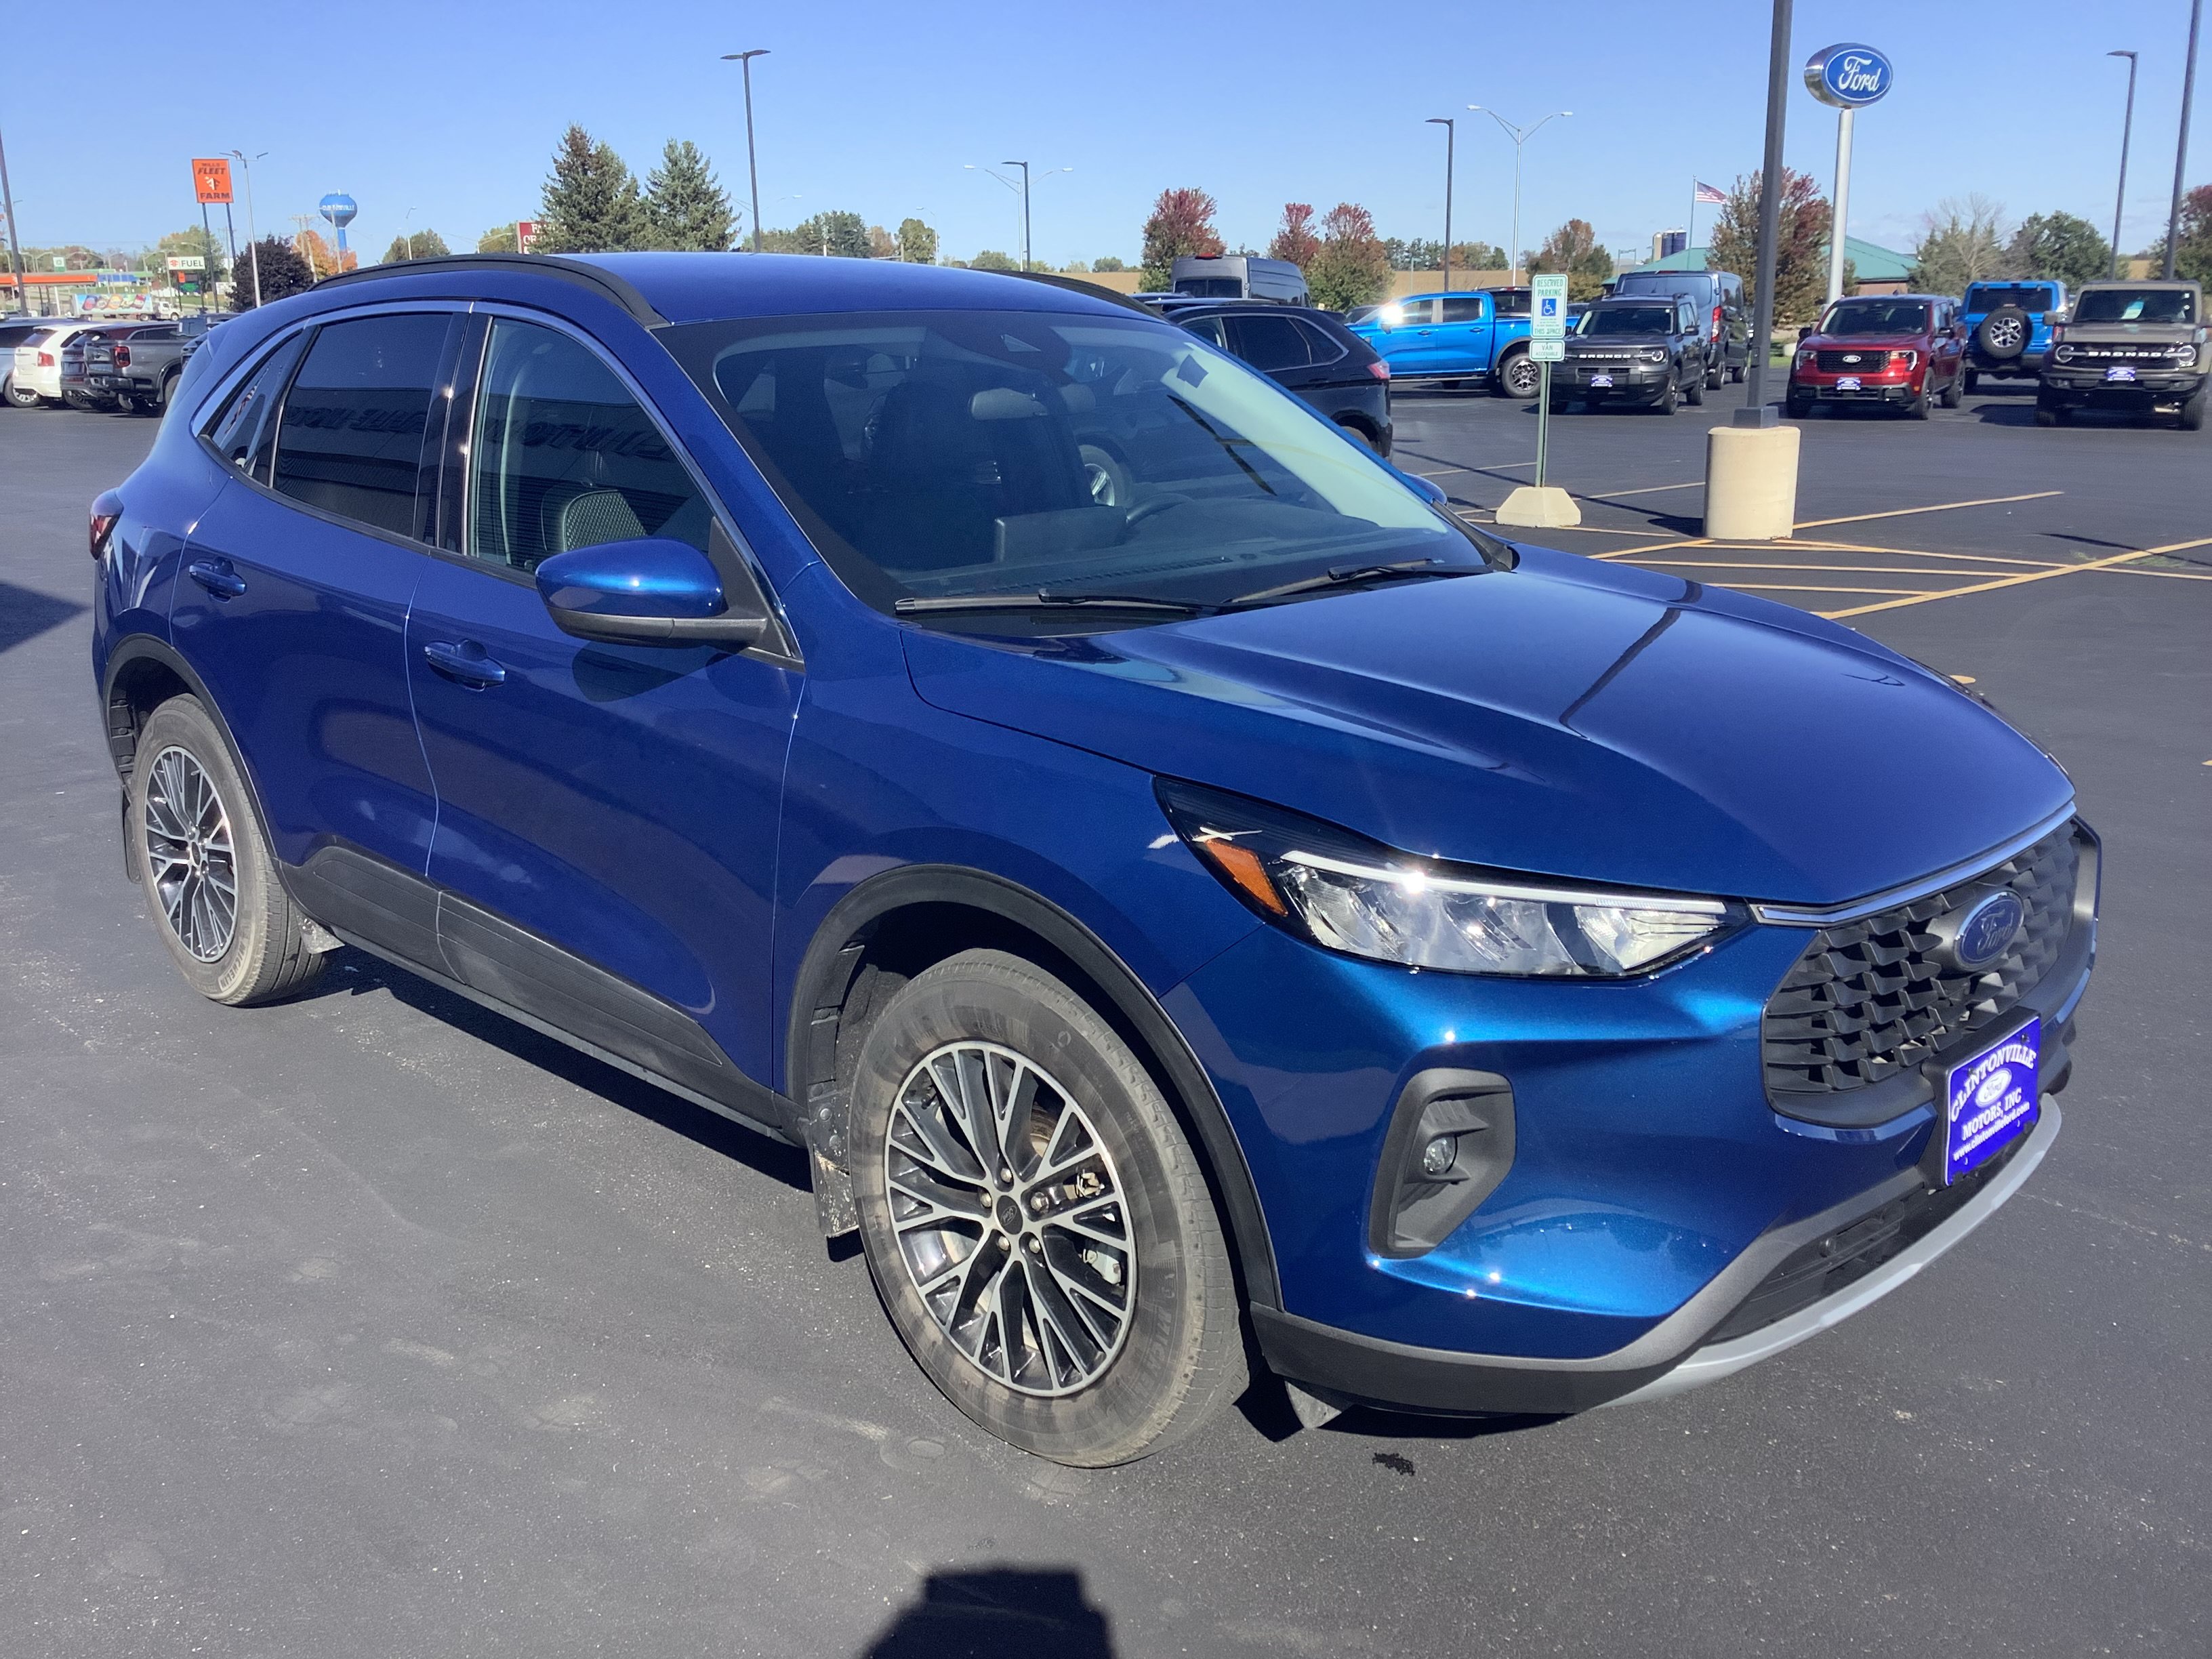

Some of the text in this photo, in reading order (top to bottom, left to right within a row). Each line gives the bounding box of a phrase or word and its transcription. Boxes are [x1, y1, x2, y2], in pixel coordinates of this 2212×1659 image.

[1839, 56, 1882, 91] Ford
[1538, 289, 1562, 297] PARKING
[1976, 909, 2014, 955] Ford
[220, 941, 246, 989] MICHELIN
[1951, 1044, 2037, 1122] CLINTONVILLE
[1952, 1101, 2030, 1162] www.clintonvilleford.com
